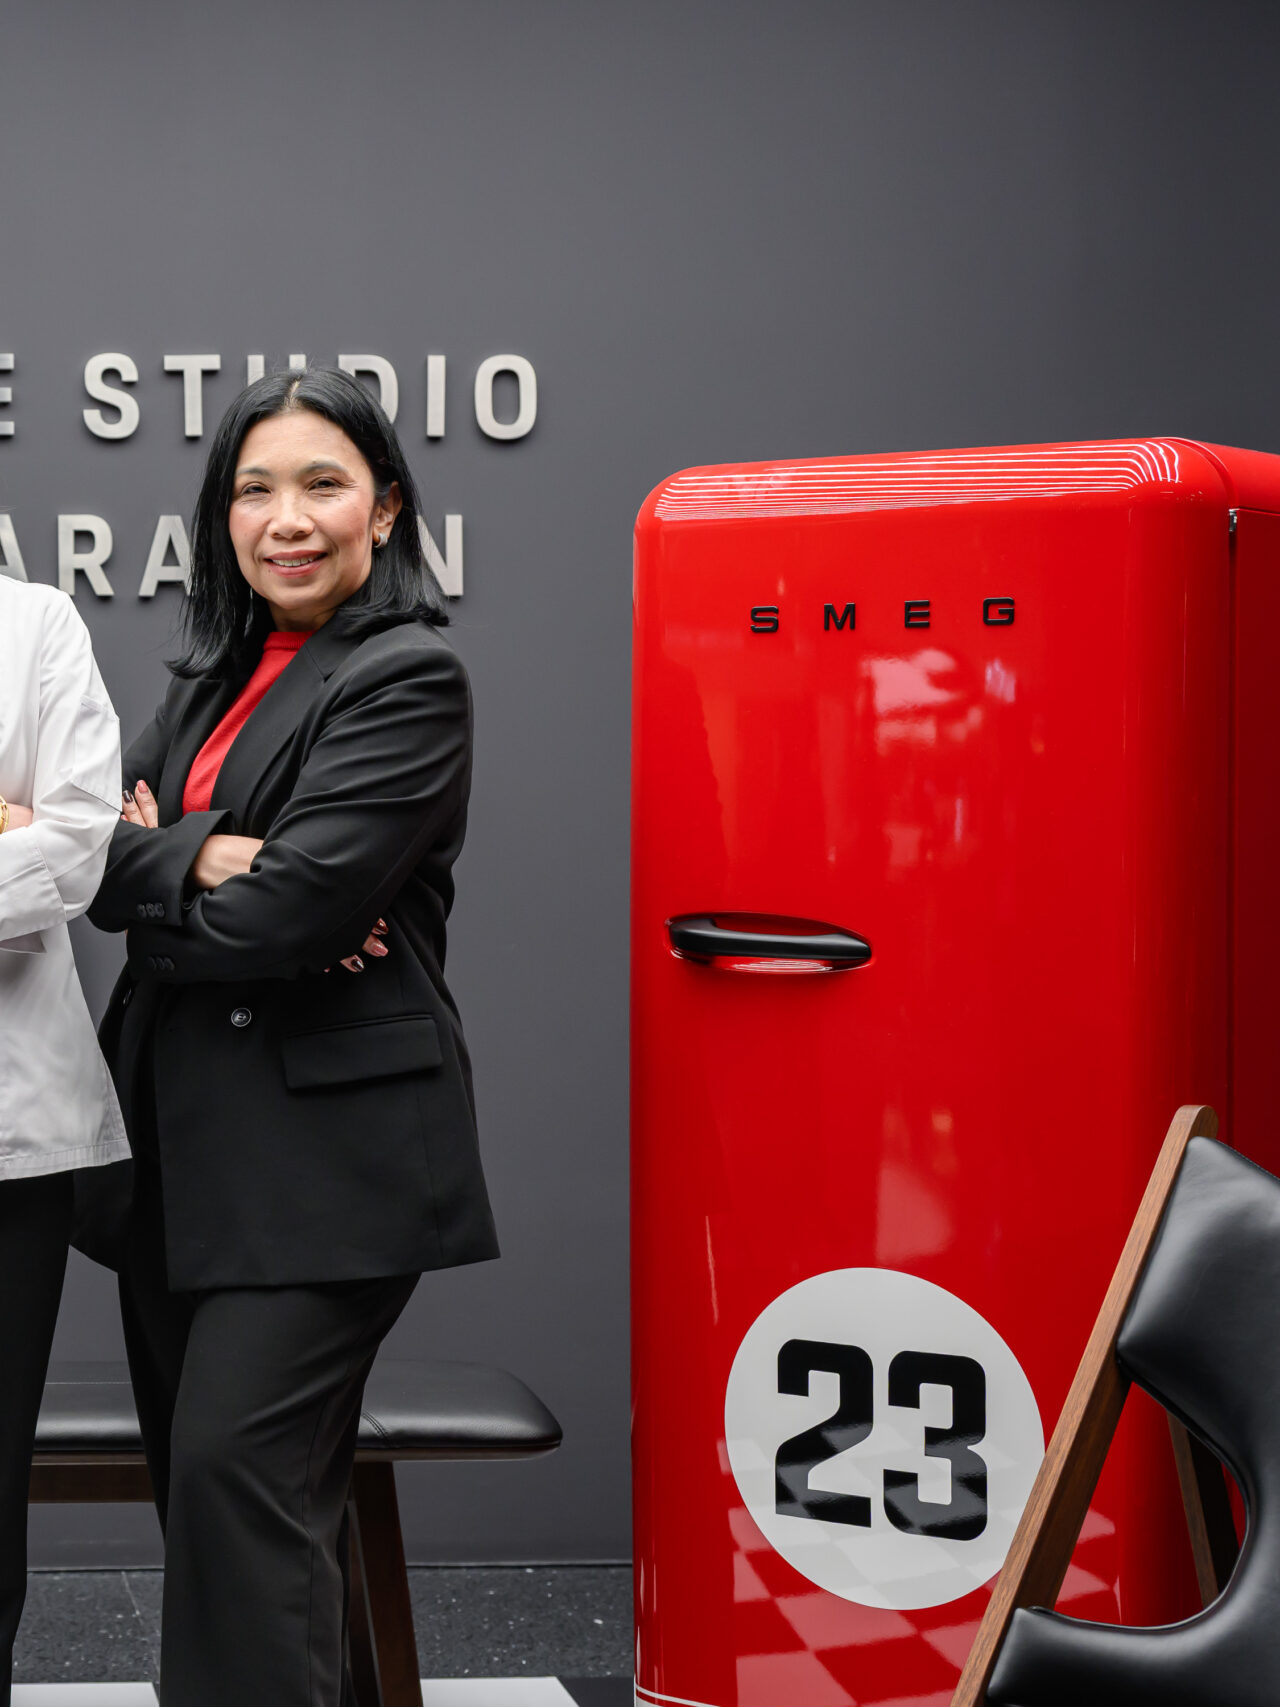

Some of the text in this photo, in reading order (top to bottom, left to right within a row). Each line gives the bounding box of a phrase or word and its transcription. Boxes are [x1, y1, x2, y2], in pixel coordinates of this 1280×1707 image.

[82, 352, 538, 441] STDIO
[750, 597, 1016, 634] SMEG
[775, 1338, 989, 1541] 23
